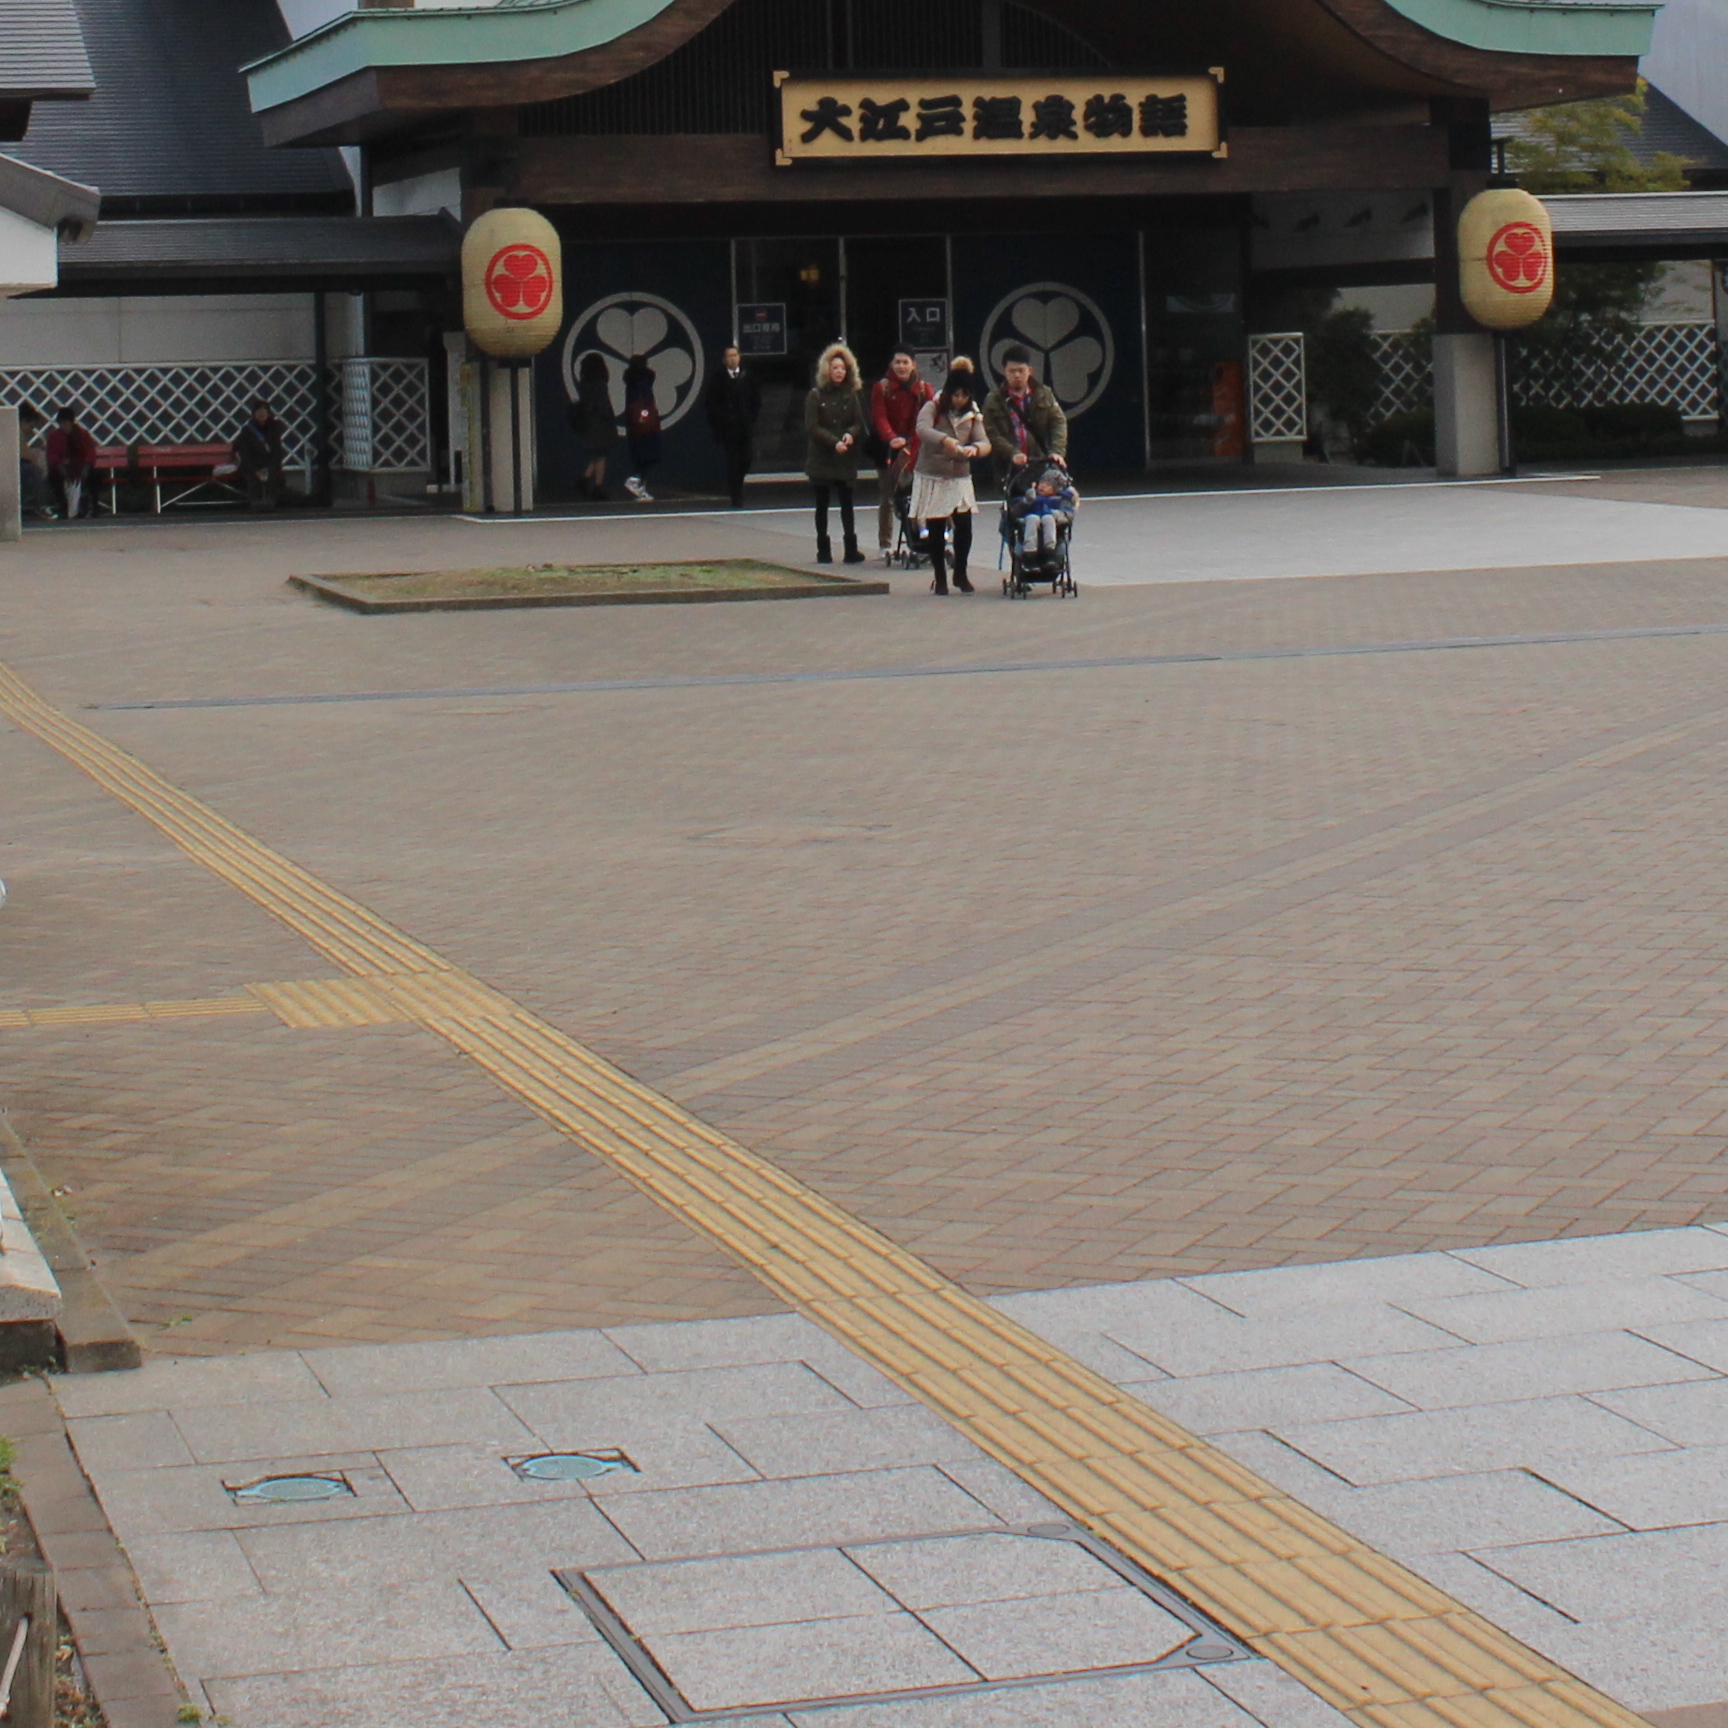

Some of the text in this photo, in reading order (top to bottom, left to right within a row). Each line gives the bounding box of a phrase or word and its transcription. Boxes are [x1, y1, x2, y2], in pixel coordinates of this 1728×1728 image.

[800, 93, 1189, 145] 大江戸温泉物語
[906, 307, 941, 324] 入口
